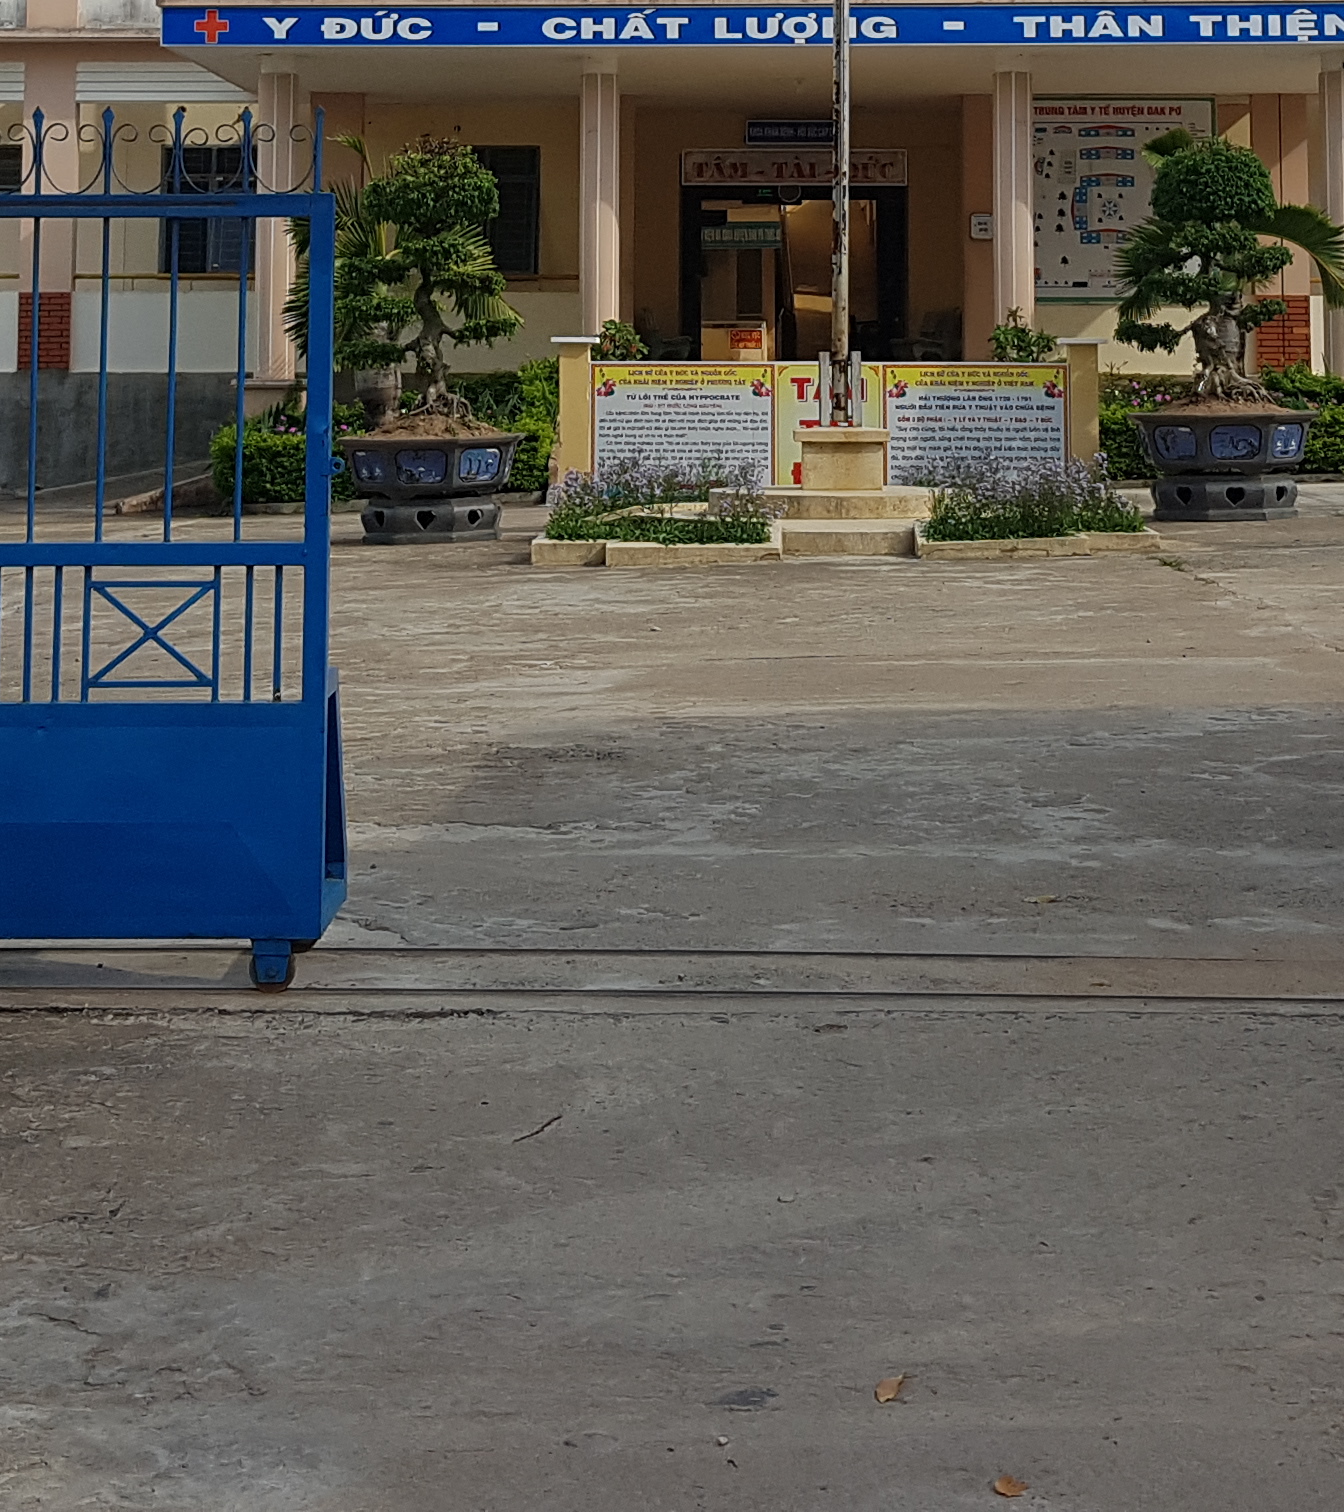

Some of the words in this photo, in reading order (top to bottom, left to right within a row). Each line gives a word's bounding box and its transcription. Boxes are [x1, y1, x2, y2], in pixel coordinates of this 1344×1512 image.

[262, 17, 302, 40] Y
[320, 10, 433, 41] ĐỨC
[541, 9, 689, 41] CHẤT
[1013, 8, 1164, 39] THÂN
[692, 155, 748, 179] TÂM
[771, 155, 817, 179] TÀI
